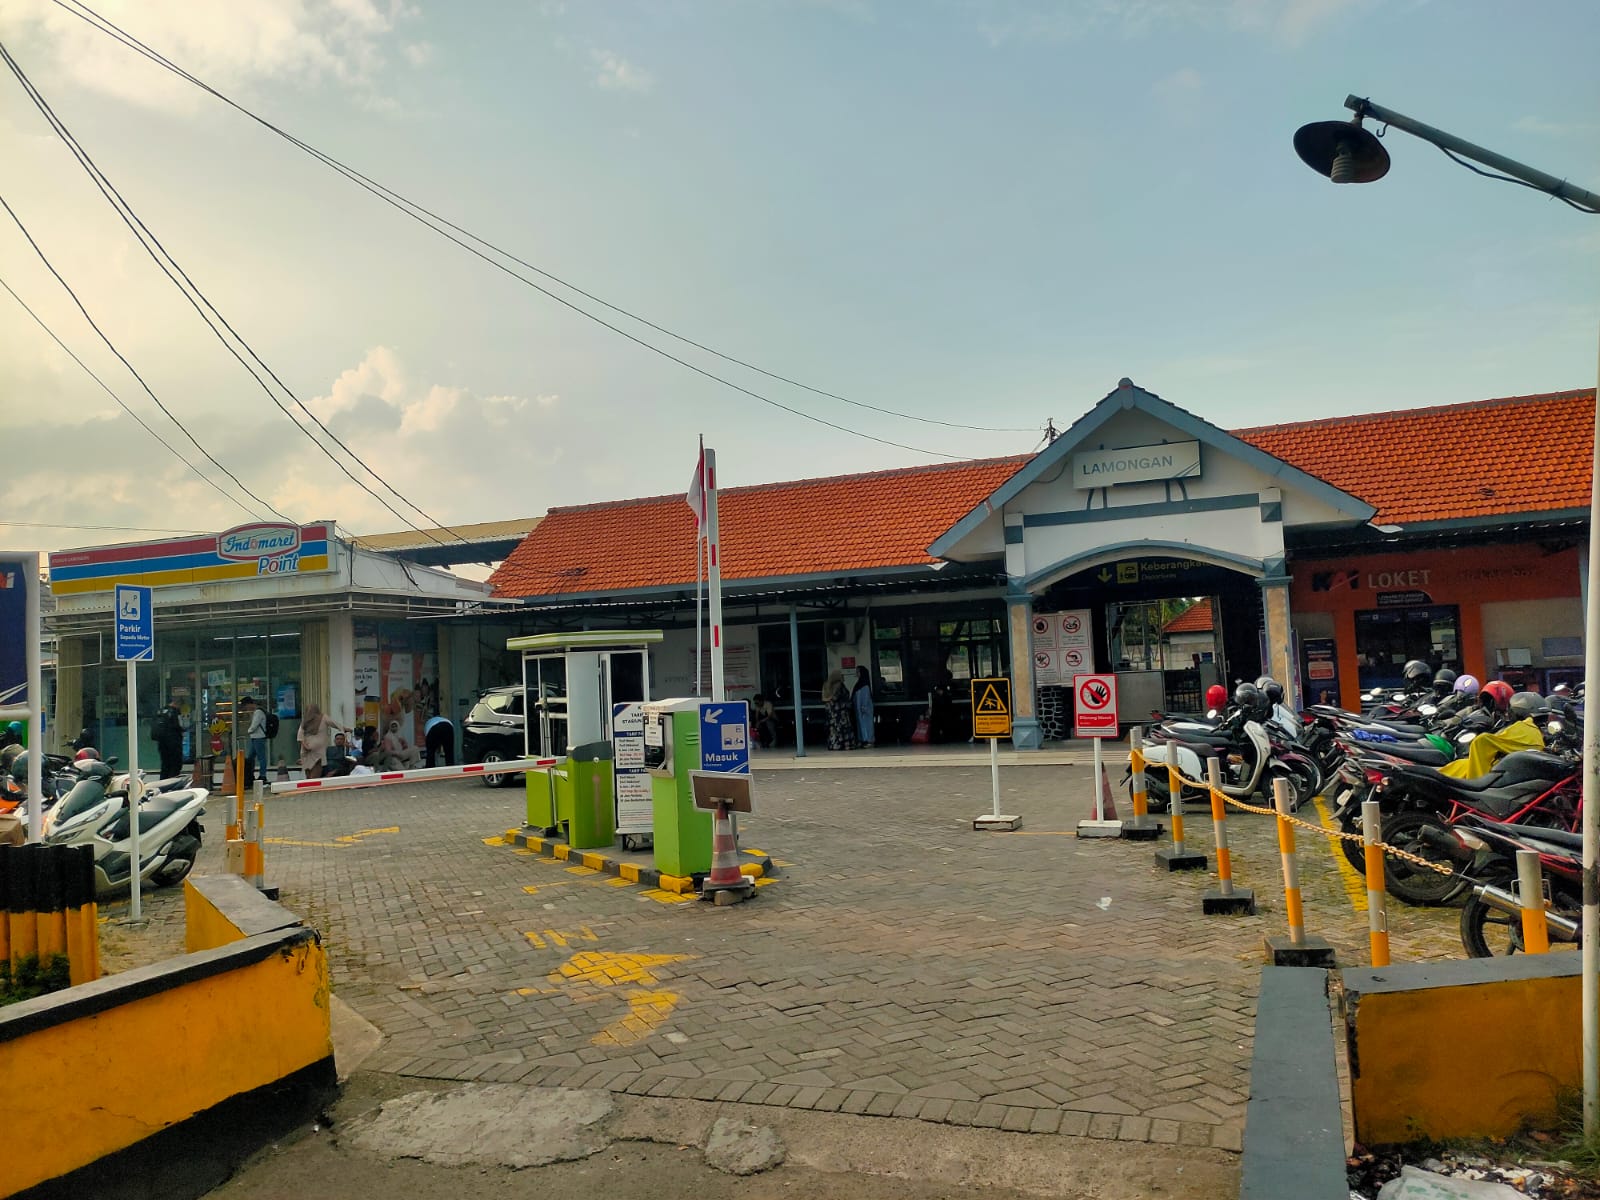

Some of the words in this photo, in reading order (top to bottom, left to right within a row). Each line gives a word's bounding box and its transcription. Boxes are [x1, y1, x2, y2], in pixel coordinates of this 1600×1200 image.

[1083, 456, 1173, 475] LAMONGAN
[224, 532, 295, 552] Indomaret
[258, 554, 299, 574] Point
[1368, 570, 1431, 588] LOKET
[119, 624, 141, 633] Parkir
[705, 752, 739, 762] Masuk
